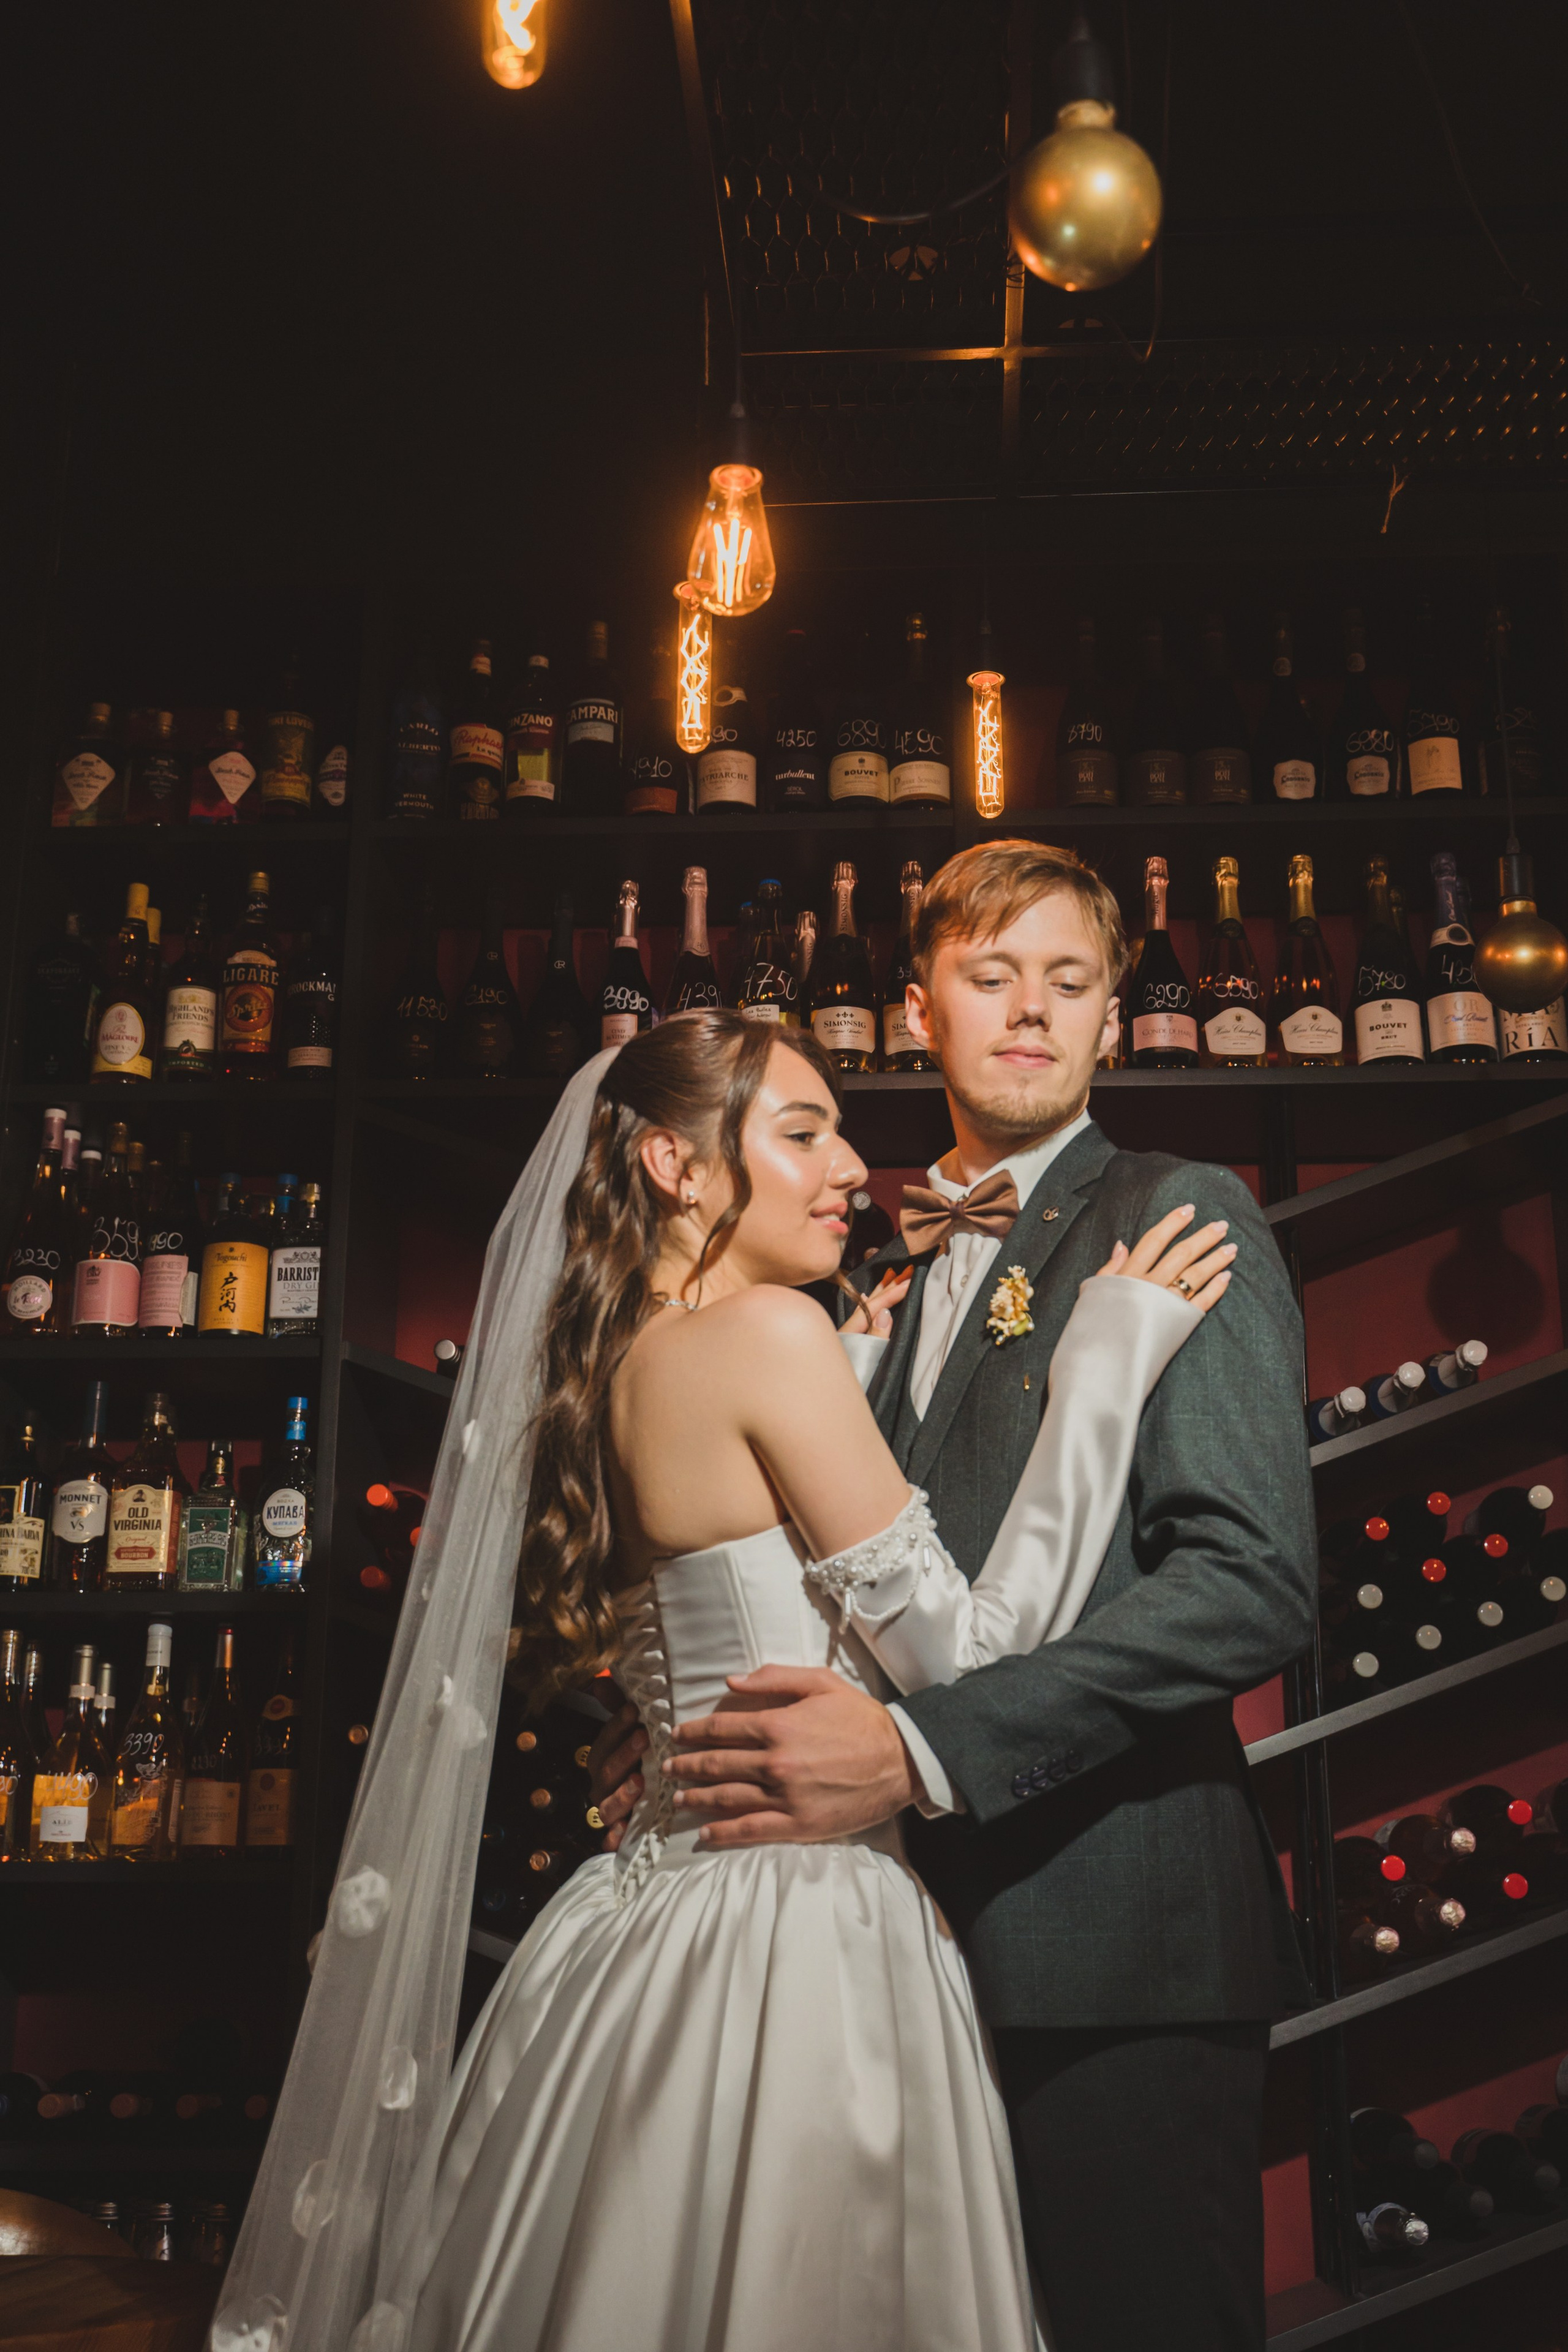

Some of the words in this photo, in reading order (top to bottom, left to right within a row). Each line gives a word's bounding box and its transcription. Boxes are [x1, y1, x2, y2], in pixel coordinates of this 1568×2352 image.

[776, 729, 817, 747] 4250
[837, 719, 887, 748] 6890
[894, 728, 944, 755] 4590
[1346, 729, 1395, 753] 6980
[223, 967, 279, 986] LIGARE
[1358, 965, 1406, 996] 5780
[1212, 972, 1259, 1000] 6590
[603, 985, 649, 1012] 3990
[1143, 983, 1191, 1009] 6290
[172, 1012, 209, 1022] FRIENDS
[824, 1020, 867, 1028] SIMONSIG
[1370, 1022, 1407, 1031] BOUVET
[14, 1248, 61, 1270] 3230
[215, 1252, 247, 1263] Togouchi
[276, 1267, 318, 1281] BARRIST
[59, 1494, 102, 1505] MONNET
[127, 1507, 149, 1518] OLD
[266, 1505, 305, 1519] КУПАВА
[70, 1520, 85, 1531] VS
[114, 1519, 162, 1531] VIRGINIA
[121, 1732, 164, 1756] 3390
